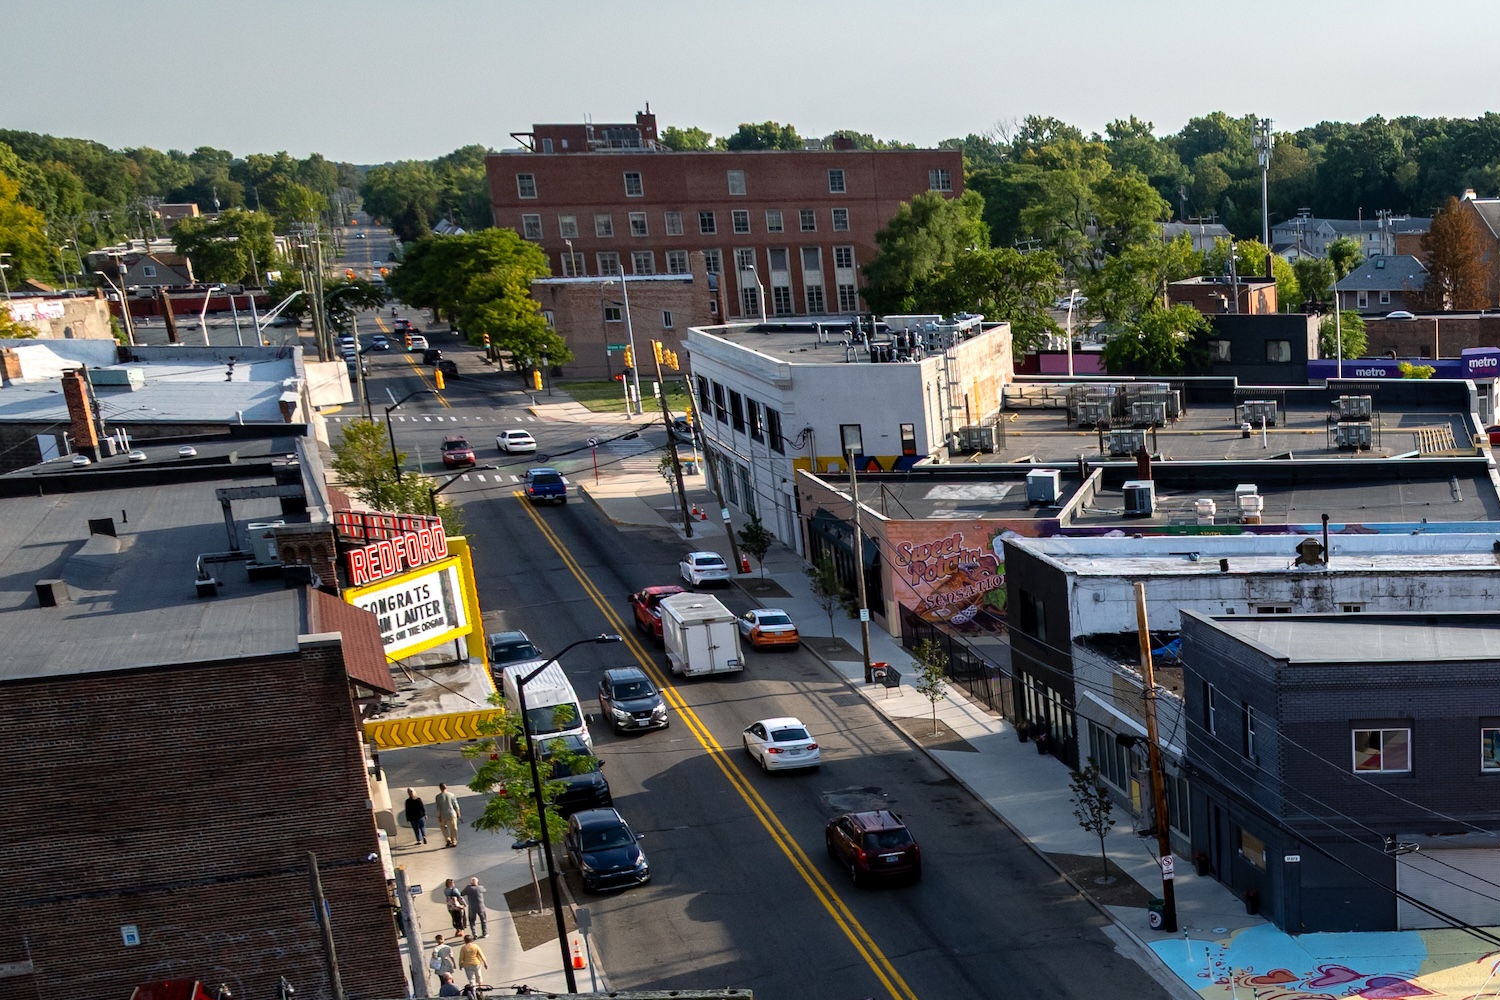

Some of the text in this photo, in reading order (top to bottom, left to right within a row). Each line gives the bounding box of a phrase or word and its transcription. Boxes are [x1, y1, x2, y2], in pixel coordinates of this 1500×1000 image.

[1355, 367, 1387, 377] metro
[1468, 356, 1498, 368] metro
[349, 524, 449, 586] REDFORD
[895, 531, 963, 567] Sweet
[395, 599, 441, 628] LAUTER
